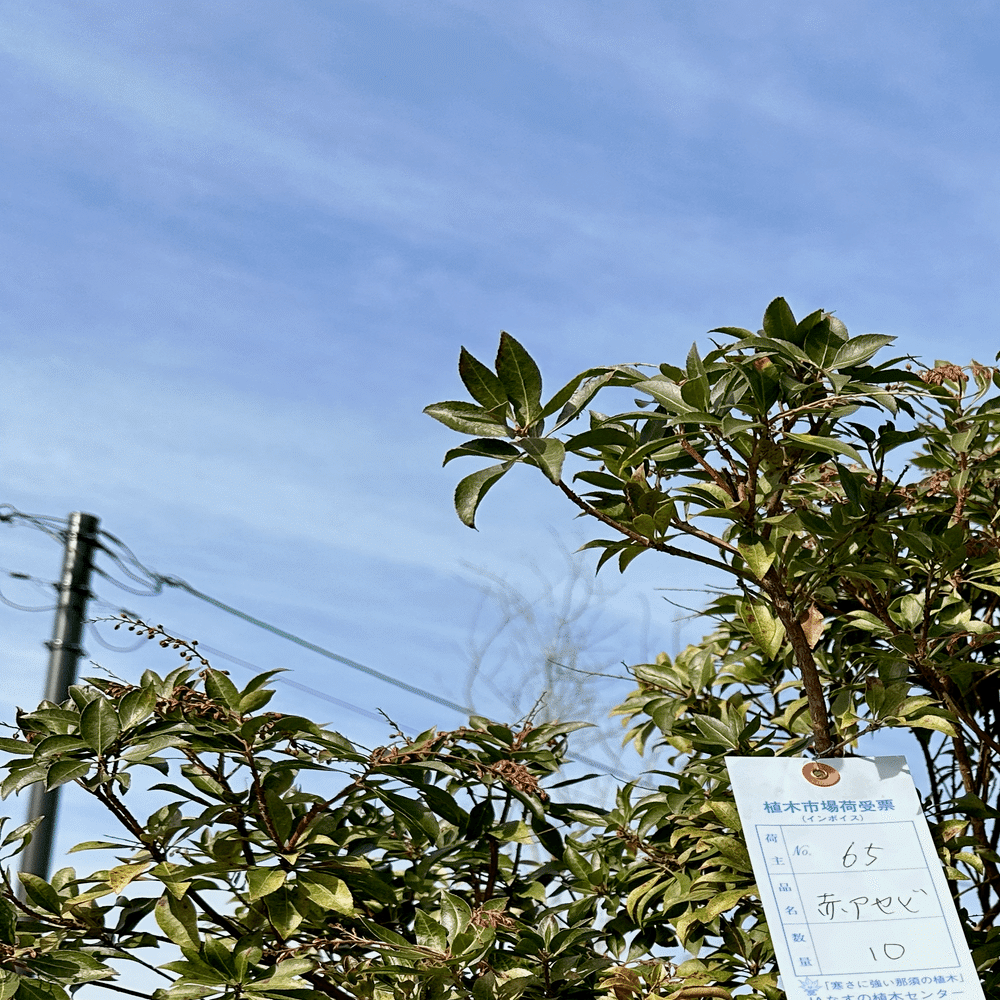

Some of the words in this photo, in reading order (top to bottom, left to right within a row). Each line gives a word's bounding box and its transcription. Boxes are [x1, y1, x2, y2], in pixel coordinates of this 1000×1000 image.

[763, 799, 896, 814] 植木市場荷受票
[842, 841, 884, 868] 65
[778, 882, 798, 916] 品名
[816, 888, 928, 920] 赤アセビ
[791, 933, 813, 967] 数量
[869, 943, 906, 961] 10
